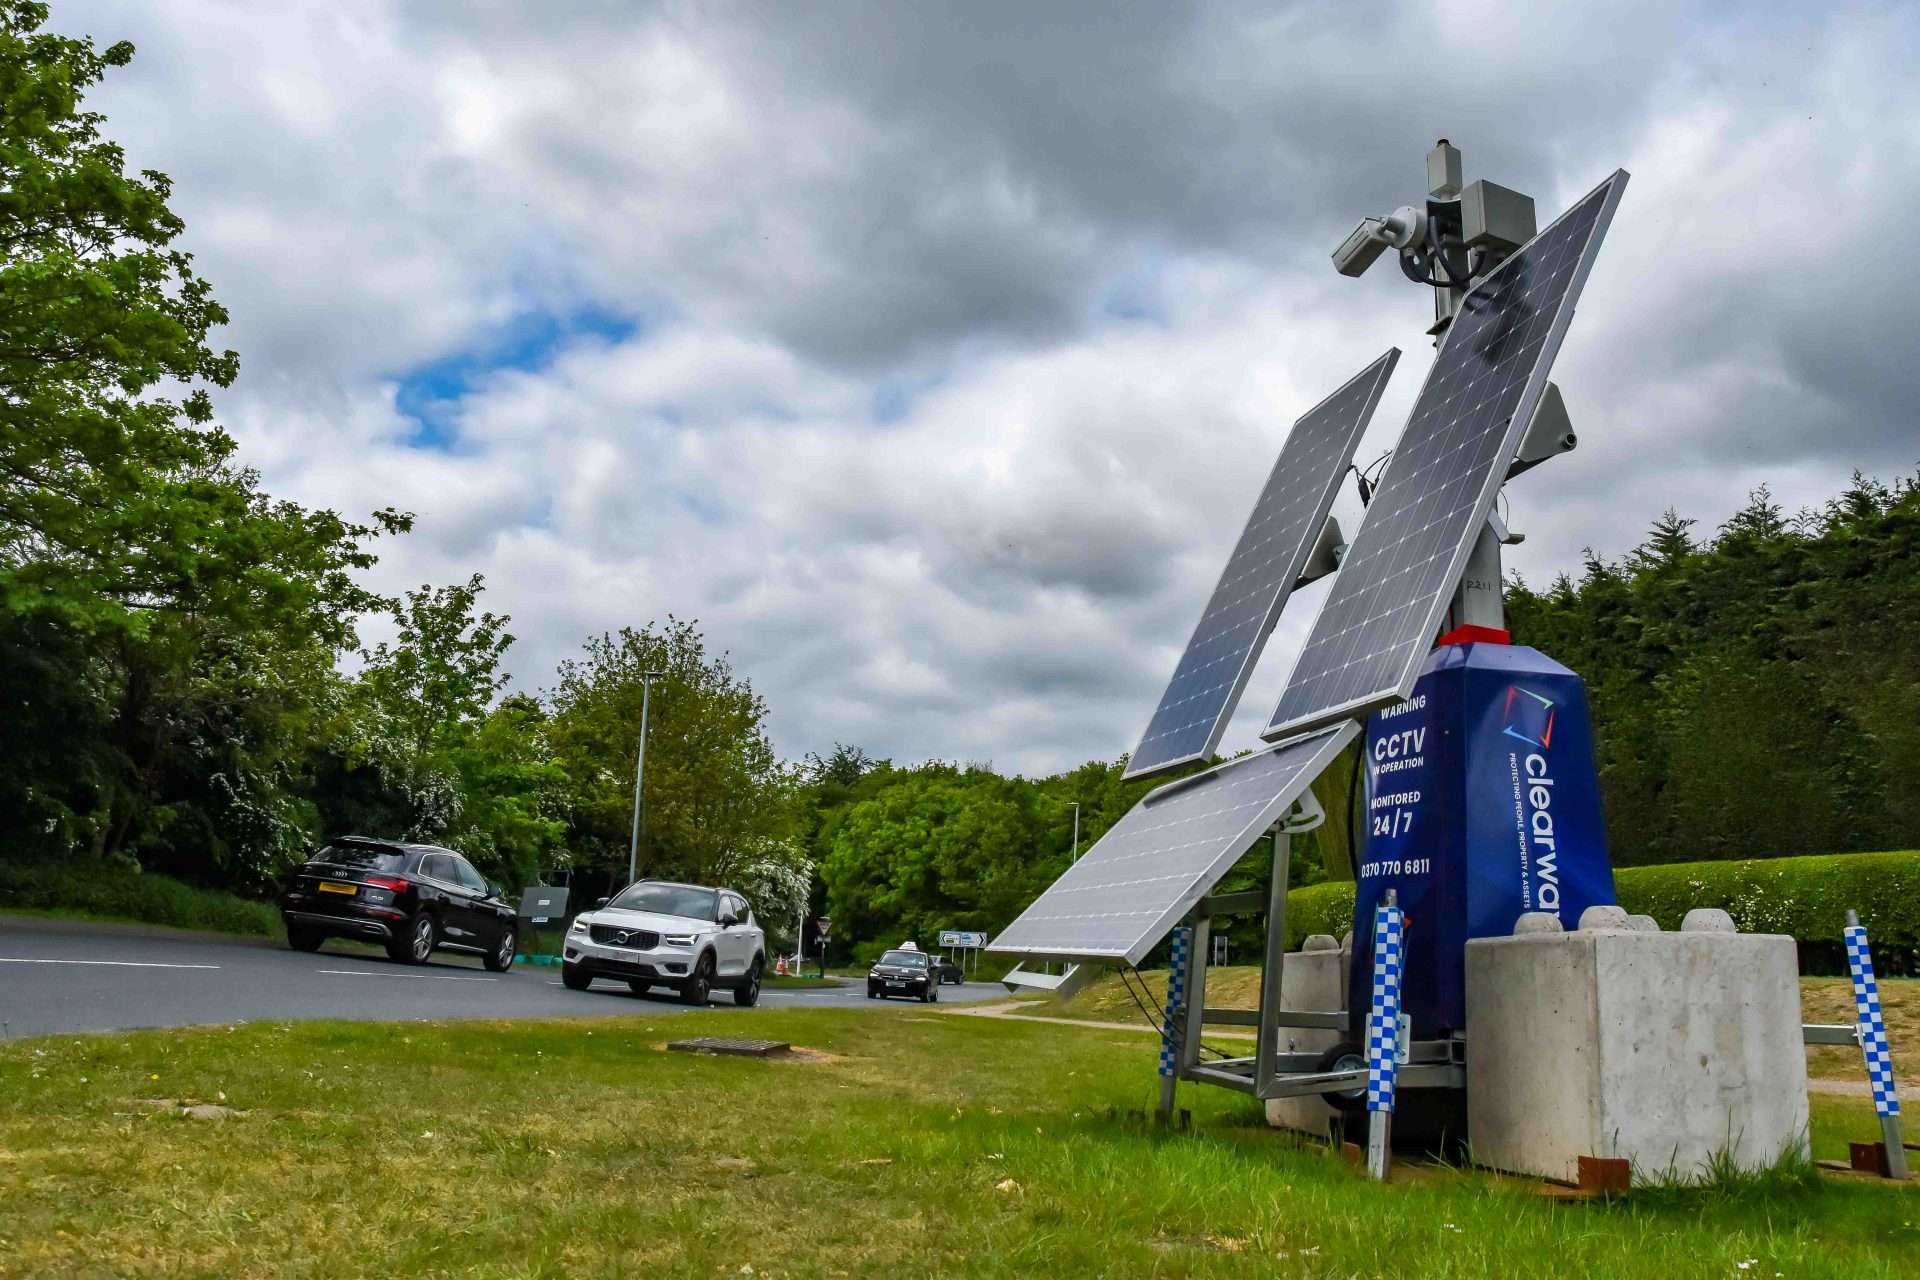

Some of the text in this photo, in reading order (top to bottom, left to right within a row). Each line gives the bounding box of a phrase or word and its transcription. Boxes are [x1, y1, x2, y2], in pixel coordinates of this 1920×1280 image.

[1381, 694, 1426, 720] WARNING
[1375, 726, 1426, 761] CCTV
[1373, 756, 1424, 777] IN OPERATION
[1509, 752, 1521, 800] PROTECTING
[1370, 791, 1421, 810] MONITORED
[1373, 807, 1413, 839] 24/7
[1525, 753, 1560, 919] clearwa
[1518, 831, 1528, 870] PROPERTY
[1361, 858, 1430, 878] 0370 770 6811
[1522, 879, 1531, 909] ASSETS
